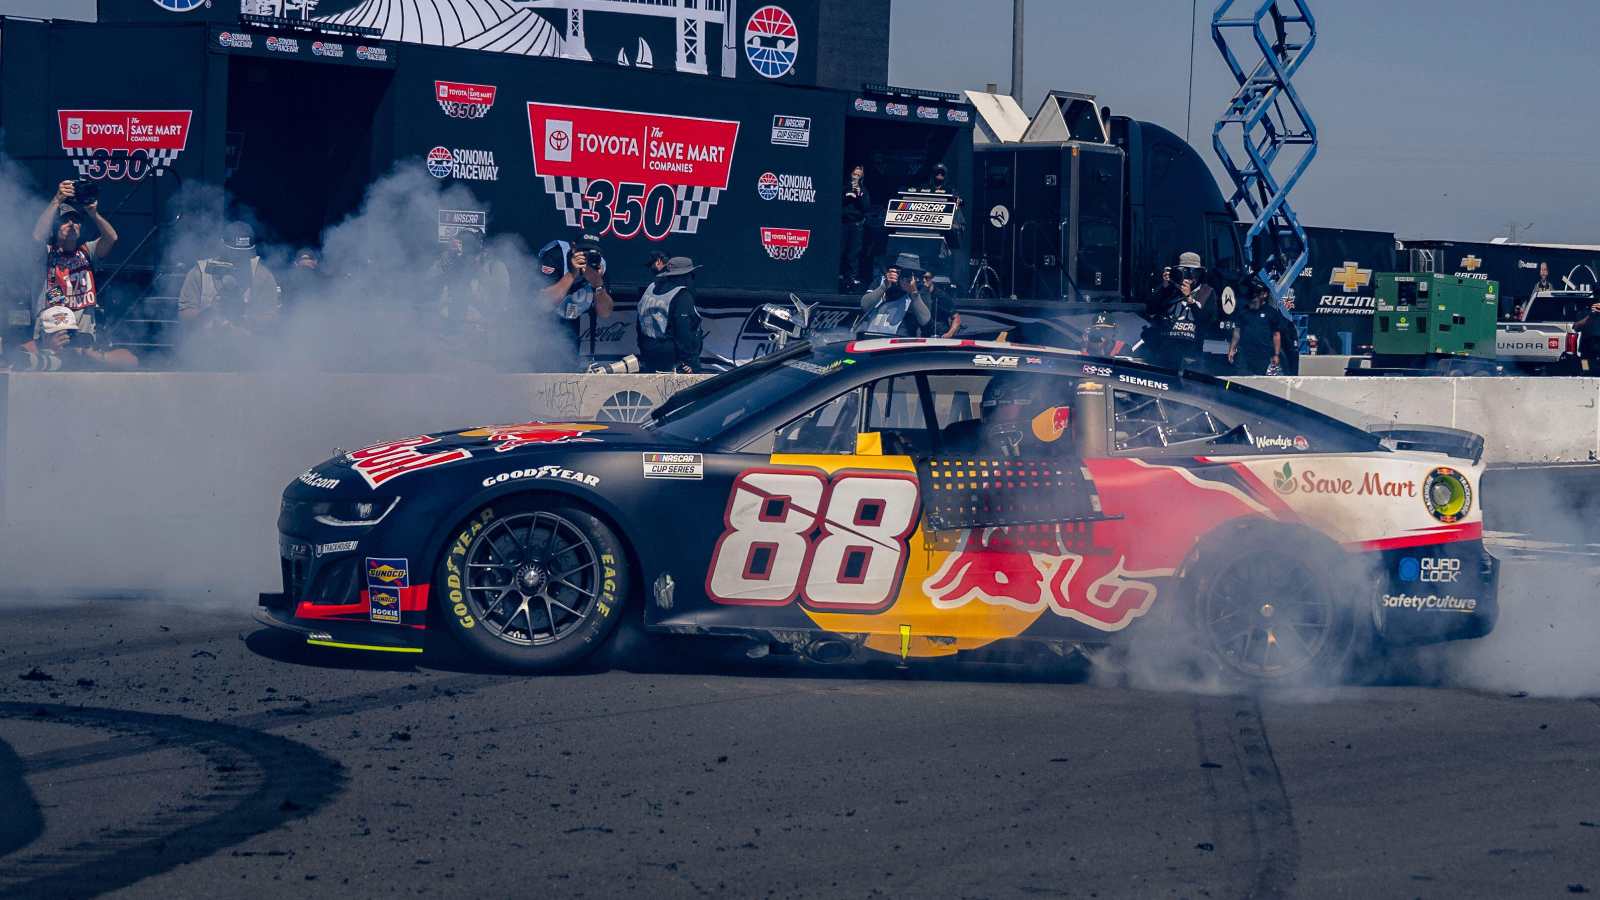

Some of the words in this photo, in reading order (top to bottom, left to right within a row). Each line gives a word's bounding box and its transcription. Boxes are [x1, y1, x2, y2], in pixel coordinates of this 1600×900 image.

[448, 102, 478, 119] 350
[85, 124, 124, 135] TOYOTA
[131, 125, 153, 135] SAVE
[155, 125, 182, 135] MART
[785, 119, 806, 128] NASCAR
[651, 126, 664, 138] The
[577, 133, 639, 156] TOYOTA
[650, 140, 684, 160] SAVE
[687, 145, 725, 163] MART
[88, 148, 149, 180] 350
[452, 149, 494, 165] SONOMA
[452, 164, 499, 181] RACEWAY
[649, 162, 693, 173] COMPANIES
[779, 174, 812, 189] SONOMA
[778, 188, 816, 203] RACEWAY
[581, 178, 677, 240] 350
[909, 203, 946, 212] NASCAR
[895, 213, 912, 221] CUP
[912, 215, 944, 223] SERIES
[773, 245, 795, 260] 350
[1454, 272, 1488, 280] RACING
[1119, 374, 1169, 391] SIEMENS
[1255, 435, 1292, 449] Wendy's
[662, 454, 695, 463] NASCAR
[482, 465, 601, 488] GOODYEAR
[652, 465, 668, 473] CUP
[668, 466, 696, 474] SERIES
[1301, 470, 1354, 495] Save
[1357, 471, 1417, 498] Mart
[705, 467, 920, 612] 88
[447, 508, 494, 629] GOODYEAR
[1420, 557, 1460, 571] QUAD
[369, 568, 406, 578] SUNOCO
[1420, 570, 1459, 582] LOCK
[597, 553, 616, 618] EAGLE
[1382, 593, 1477, 611] SafetyCulture
[372, 608, 398, 616] ROOKIE
